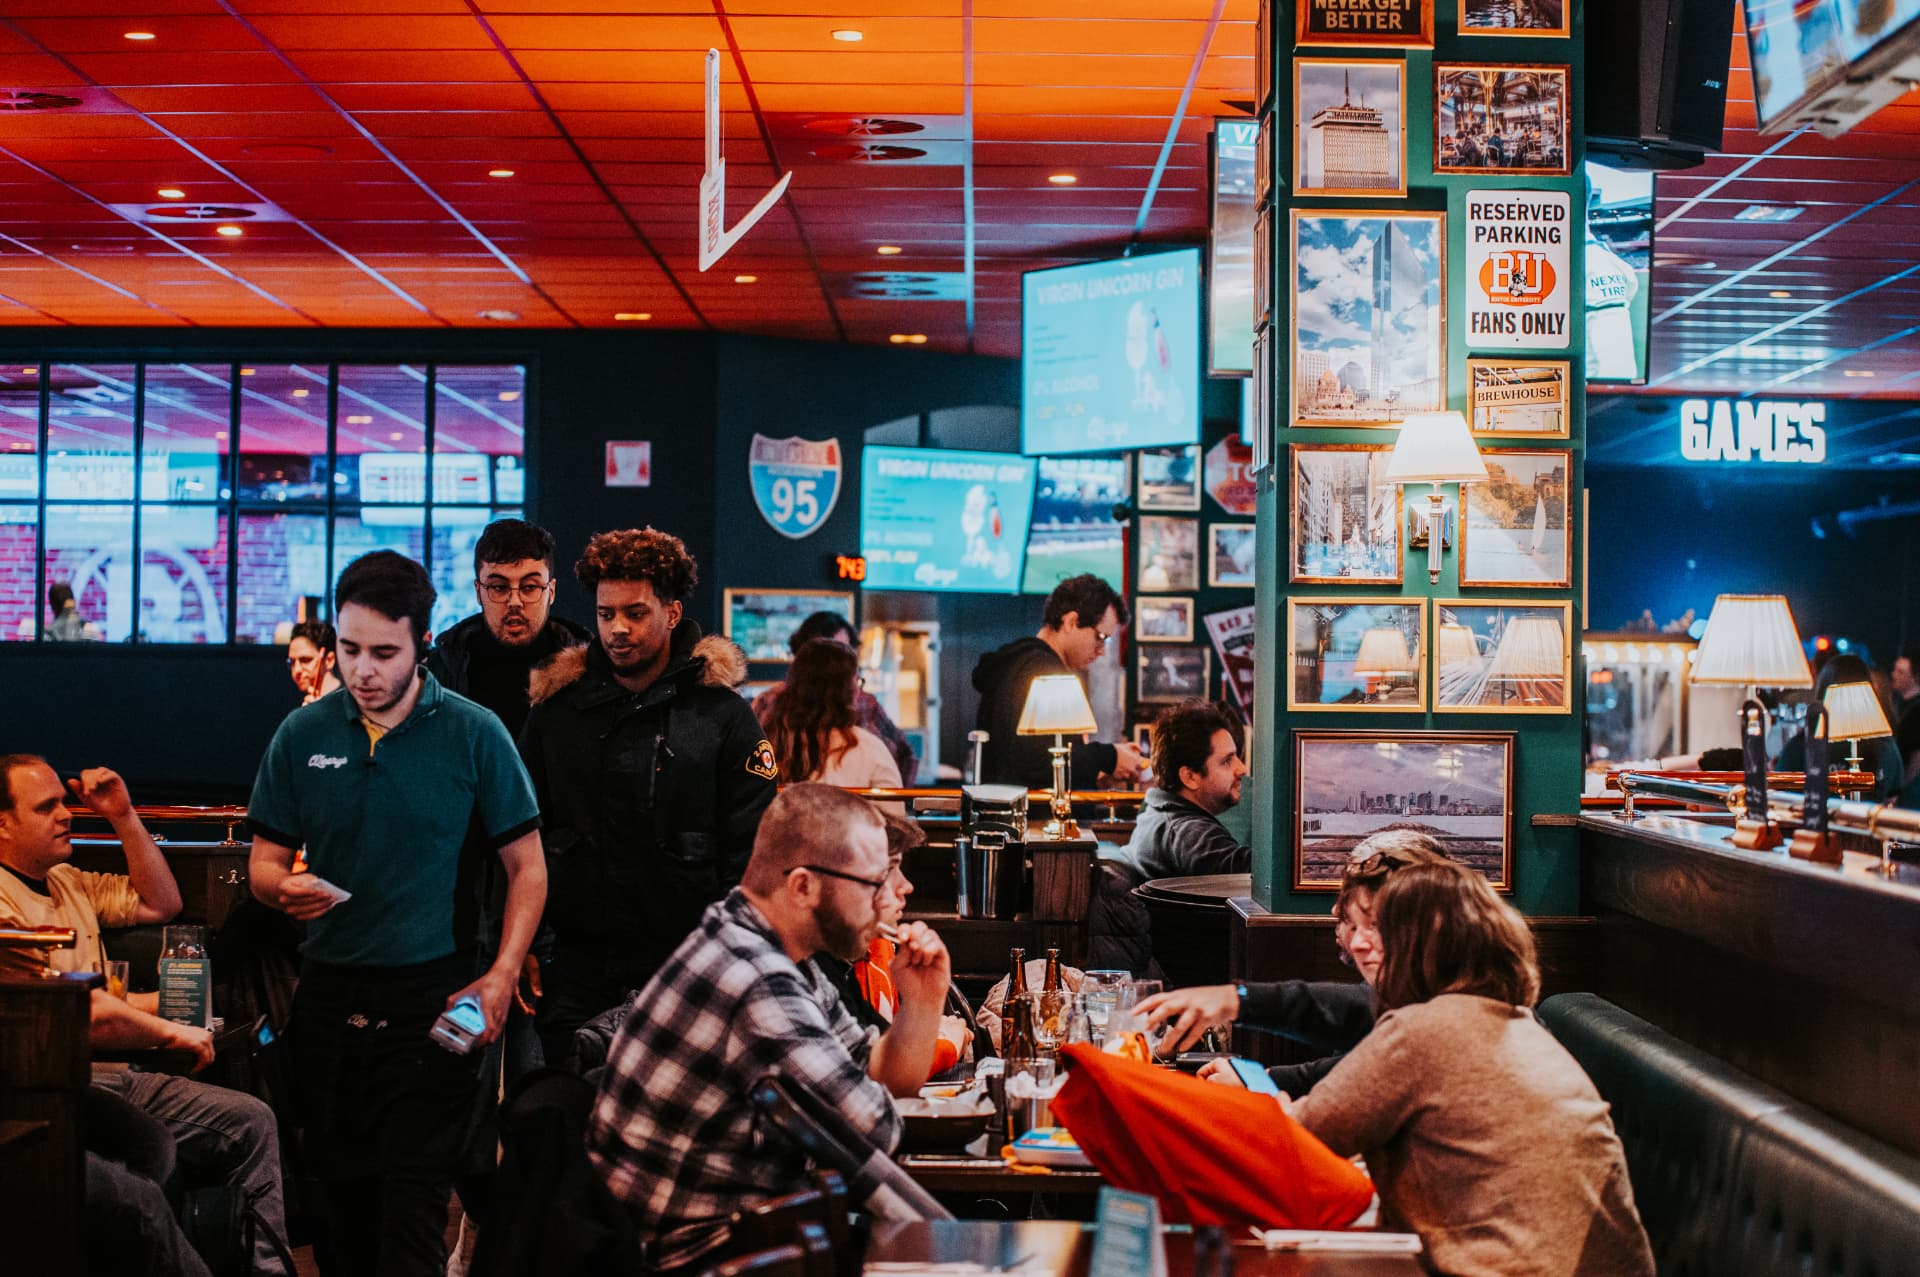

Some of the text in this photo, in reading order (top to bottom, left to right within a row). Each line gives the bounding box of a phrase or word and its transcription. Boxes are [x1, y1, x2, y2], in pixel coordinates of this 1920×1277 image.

[1326, 11, 1403, 30] BETTER
[1470, 203, 1565, 222] RESERVED
[1474, 226, 1562, 244] PARKING
[1086, 267, 1153, 300] UNICORN
[1155, 266, 1185, 290] GIN
[1489, 252, 1546, 294] BU
[1471, 312, 1566, 335] FANS ONLY
[1478, 387, 1556, 401] BREWHOUSE
[1681, 399, 1827, 464] GAMES
[771, 477, 819, 526] 95
